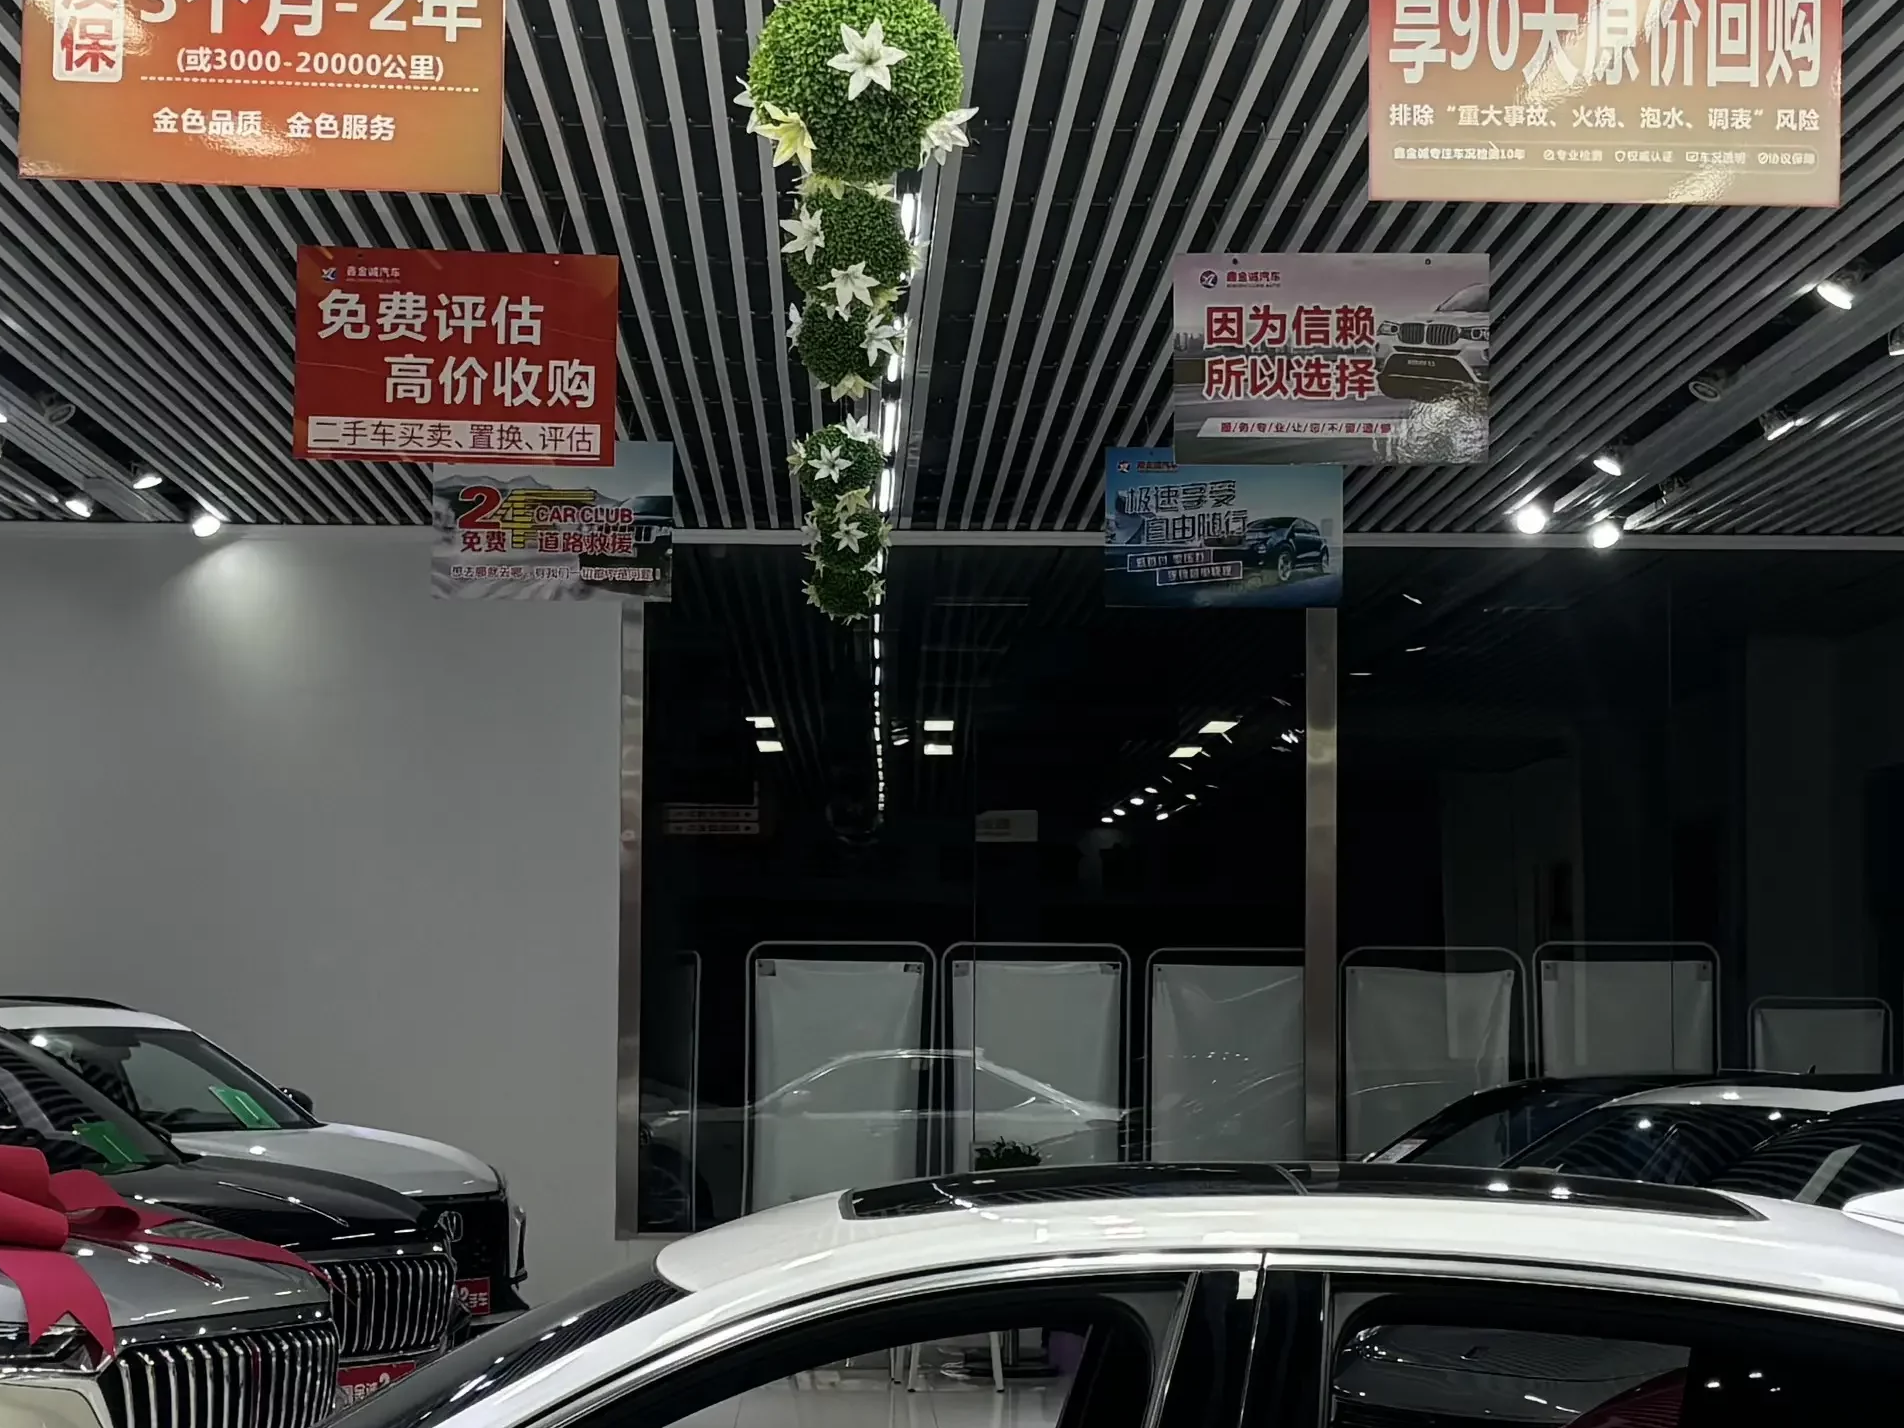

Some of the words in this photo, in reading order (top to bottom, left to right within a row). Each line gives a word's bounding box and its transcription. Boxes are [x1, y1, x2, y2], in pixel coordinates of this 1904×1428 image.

[176, 47, 444, 83] (或3000-20000公里)
[152, 107, 263, 137] 金色品质
[286, 111, 396, 143] 金色服务
[316, 287, 545, 346] 免费评估
[1204, 304, 1377, 348] 因为信赖
[383, 353, 597, 409] 高价收购
[1204, 356, 1377, 401] 所以选择
[535, 506, 581, 524] CAR
[581, 506, 635, 524] CLUB
[460, 530, 508, 553] 免费
[538, 531, 634, 555] 道路救援
